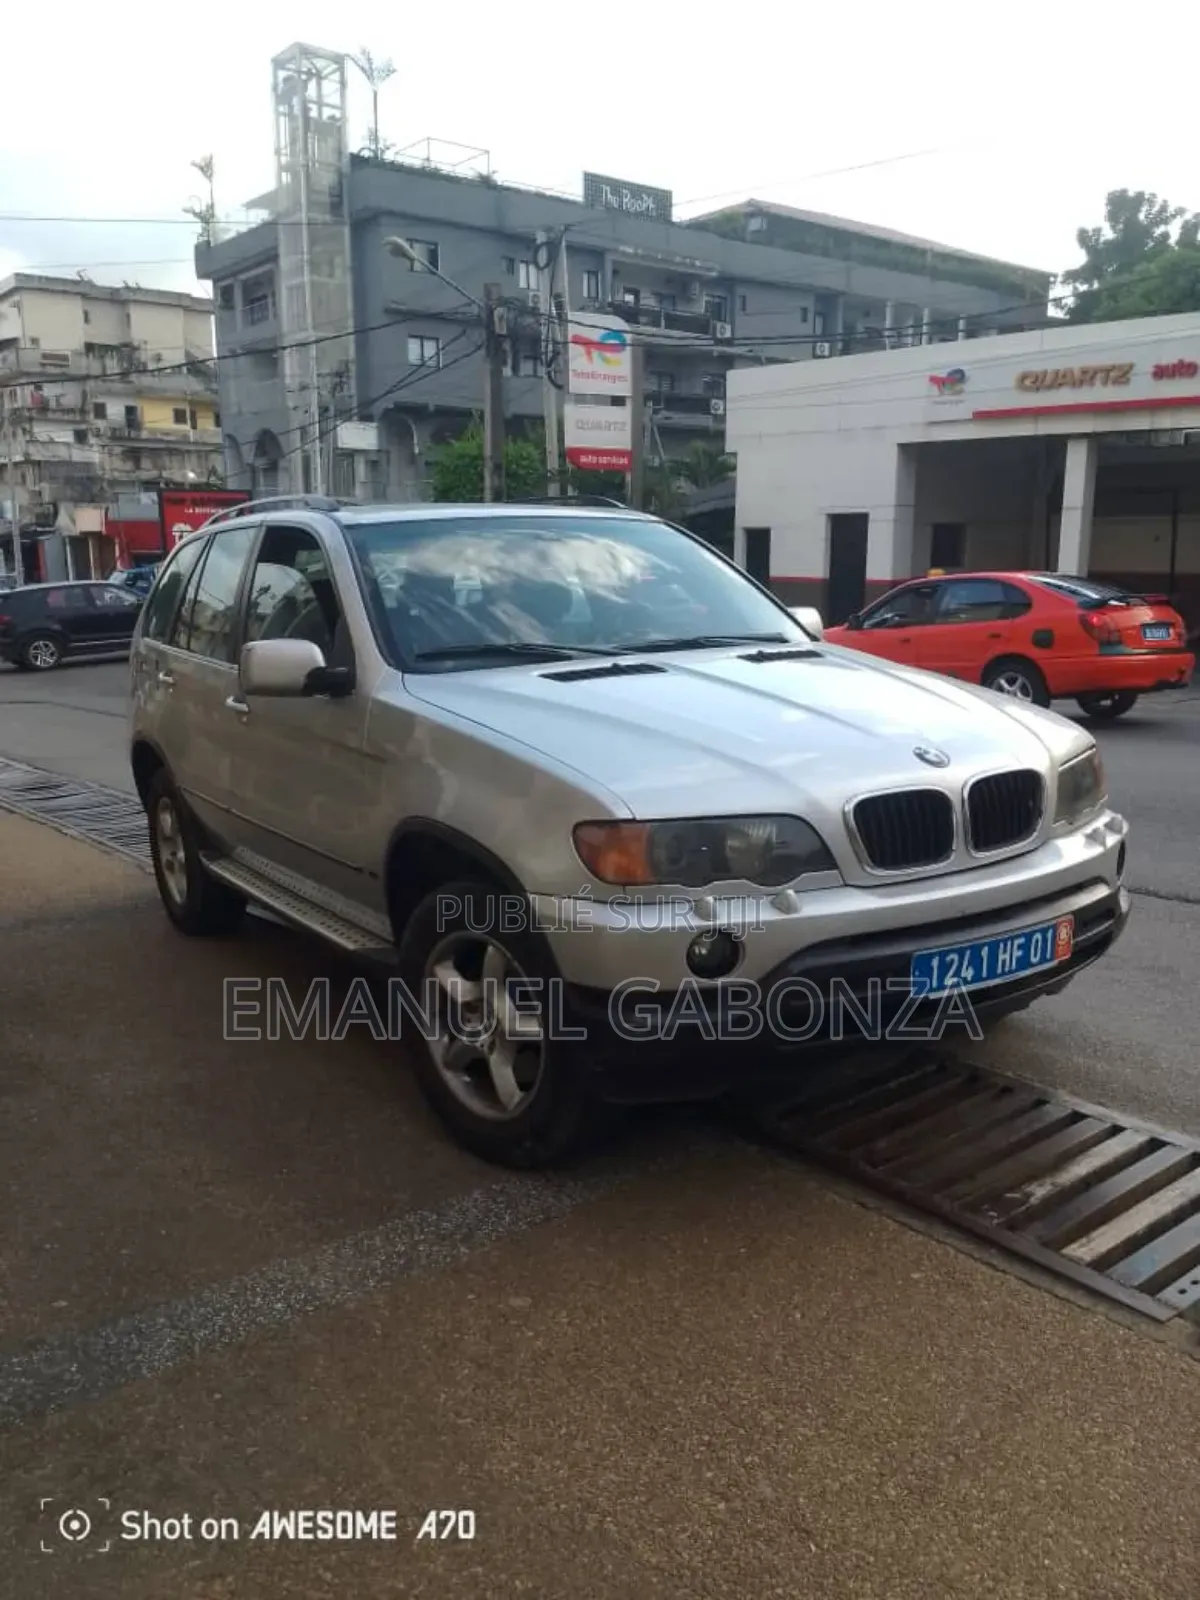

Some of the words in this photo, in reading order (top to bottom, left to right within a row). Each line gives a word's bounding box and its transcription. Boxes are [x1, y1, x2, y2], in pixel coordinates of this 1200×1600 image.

[1015, 362, 1134, 393] QUARTZ
[1152, 359, 1199, 381] auto
[931, 946, 989, 989] 1241
[997, 937, 1026, 975] HF
[1030, 928, 1053, 964] 01
